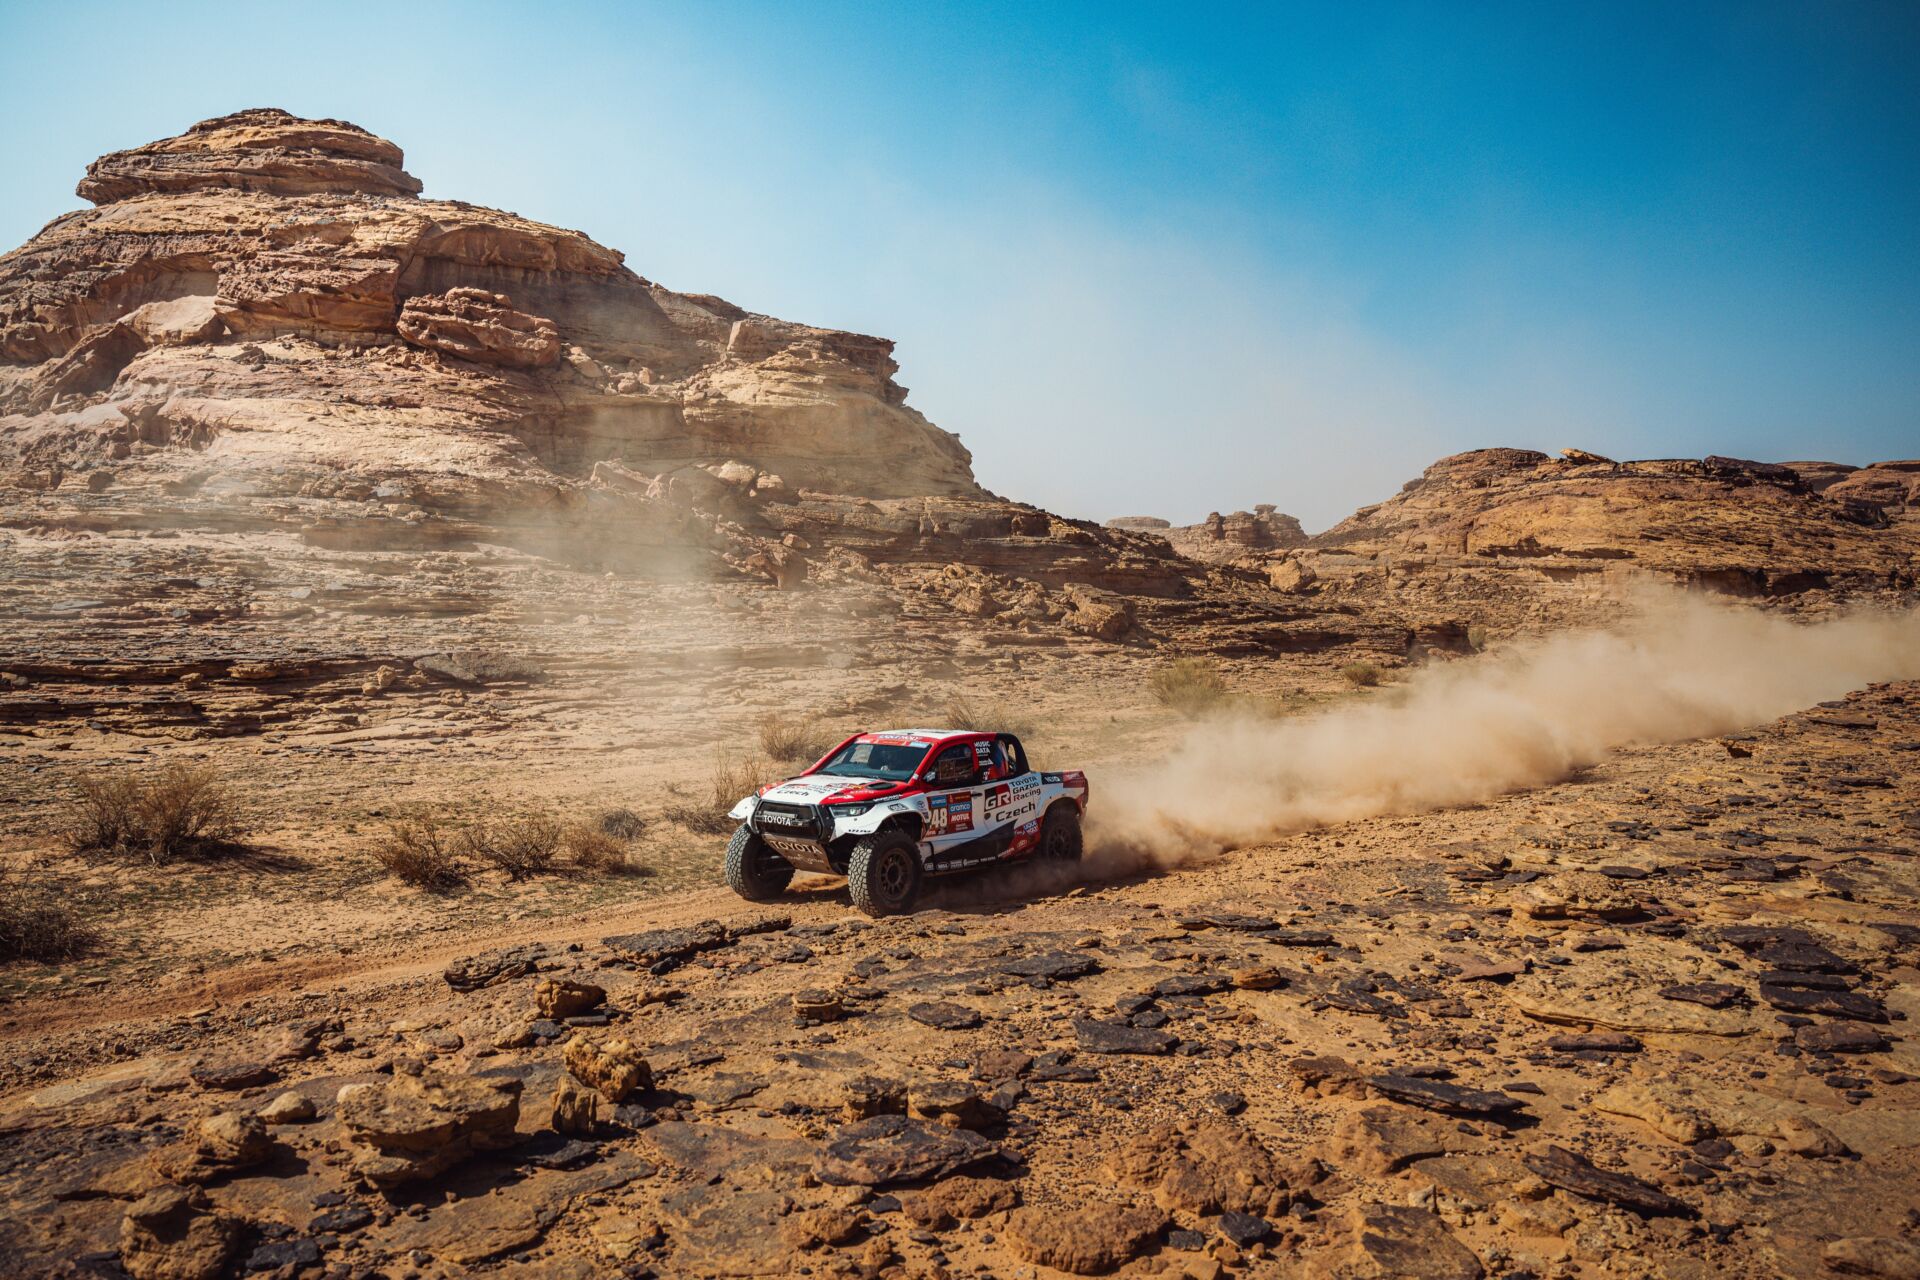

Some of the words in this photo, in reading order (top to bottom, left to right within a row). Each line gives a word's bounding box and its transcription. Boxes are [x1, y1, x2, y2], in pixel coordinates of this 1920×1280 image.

[1010, 776, 1037, 787] TOYOTA
[1012, 782, 1040, 795] GAZOO
[1013, 788, 1041, 802] Racing
[950, 803, 970, 812] aramco
[985, 791, 1011, 811] GR
[951, 813, 970, 822] MOTUL
[996, 801, 1036, 822] Czech
[763, 815, 791, 826] TOYOTA
[769, 840, 823, 855] TOYOTA
